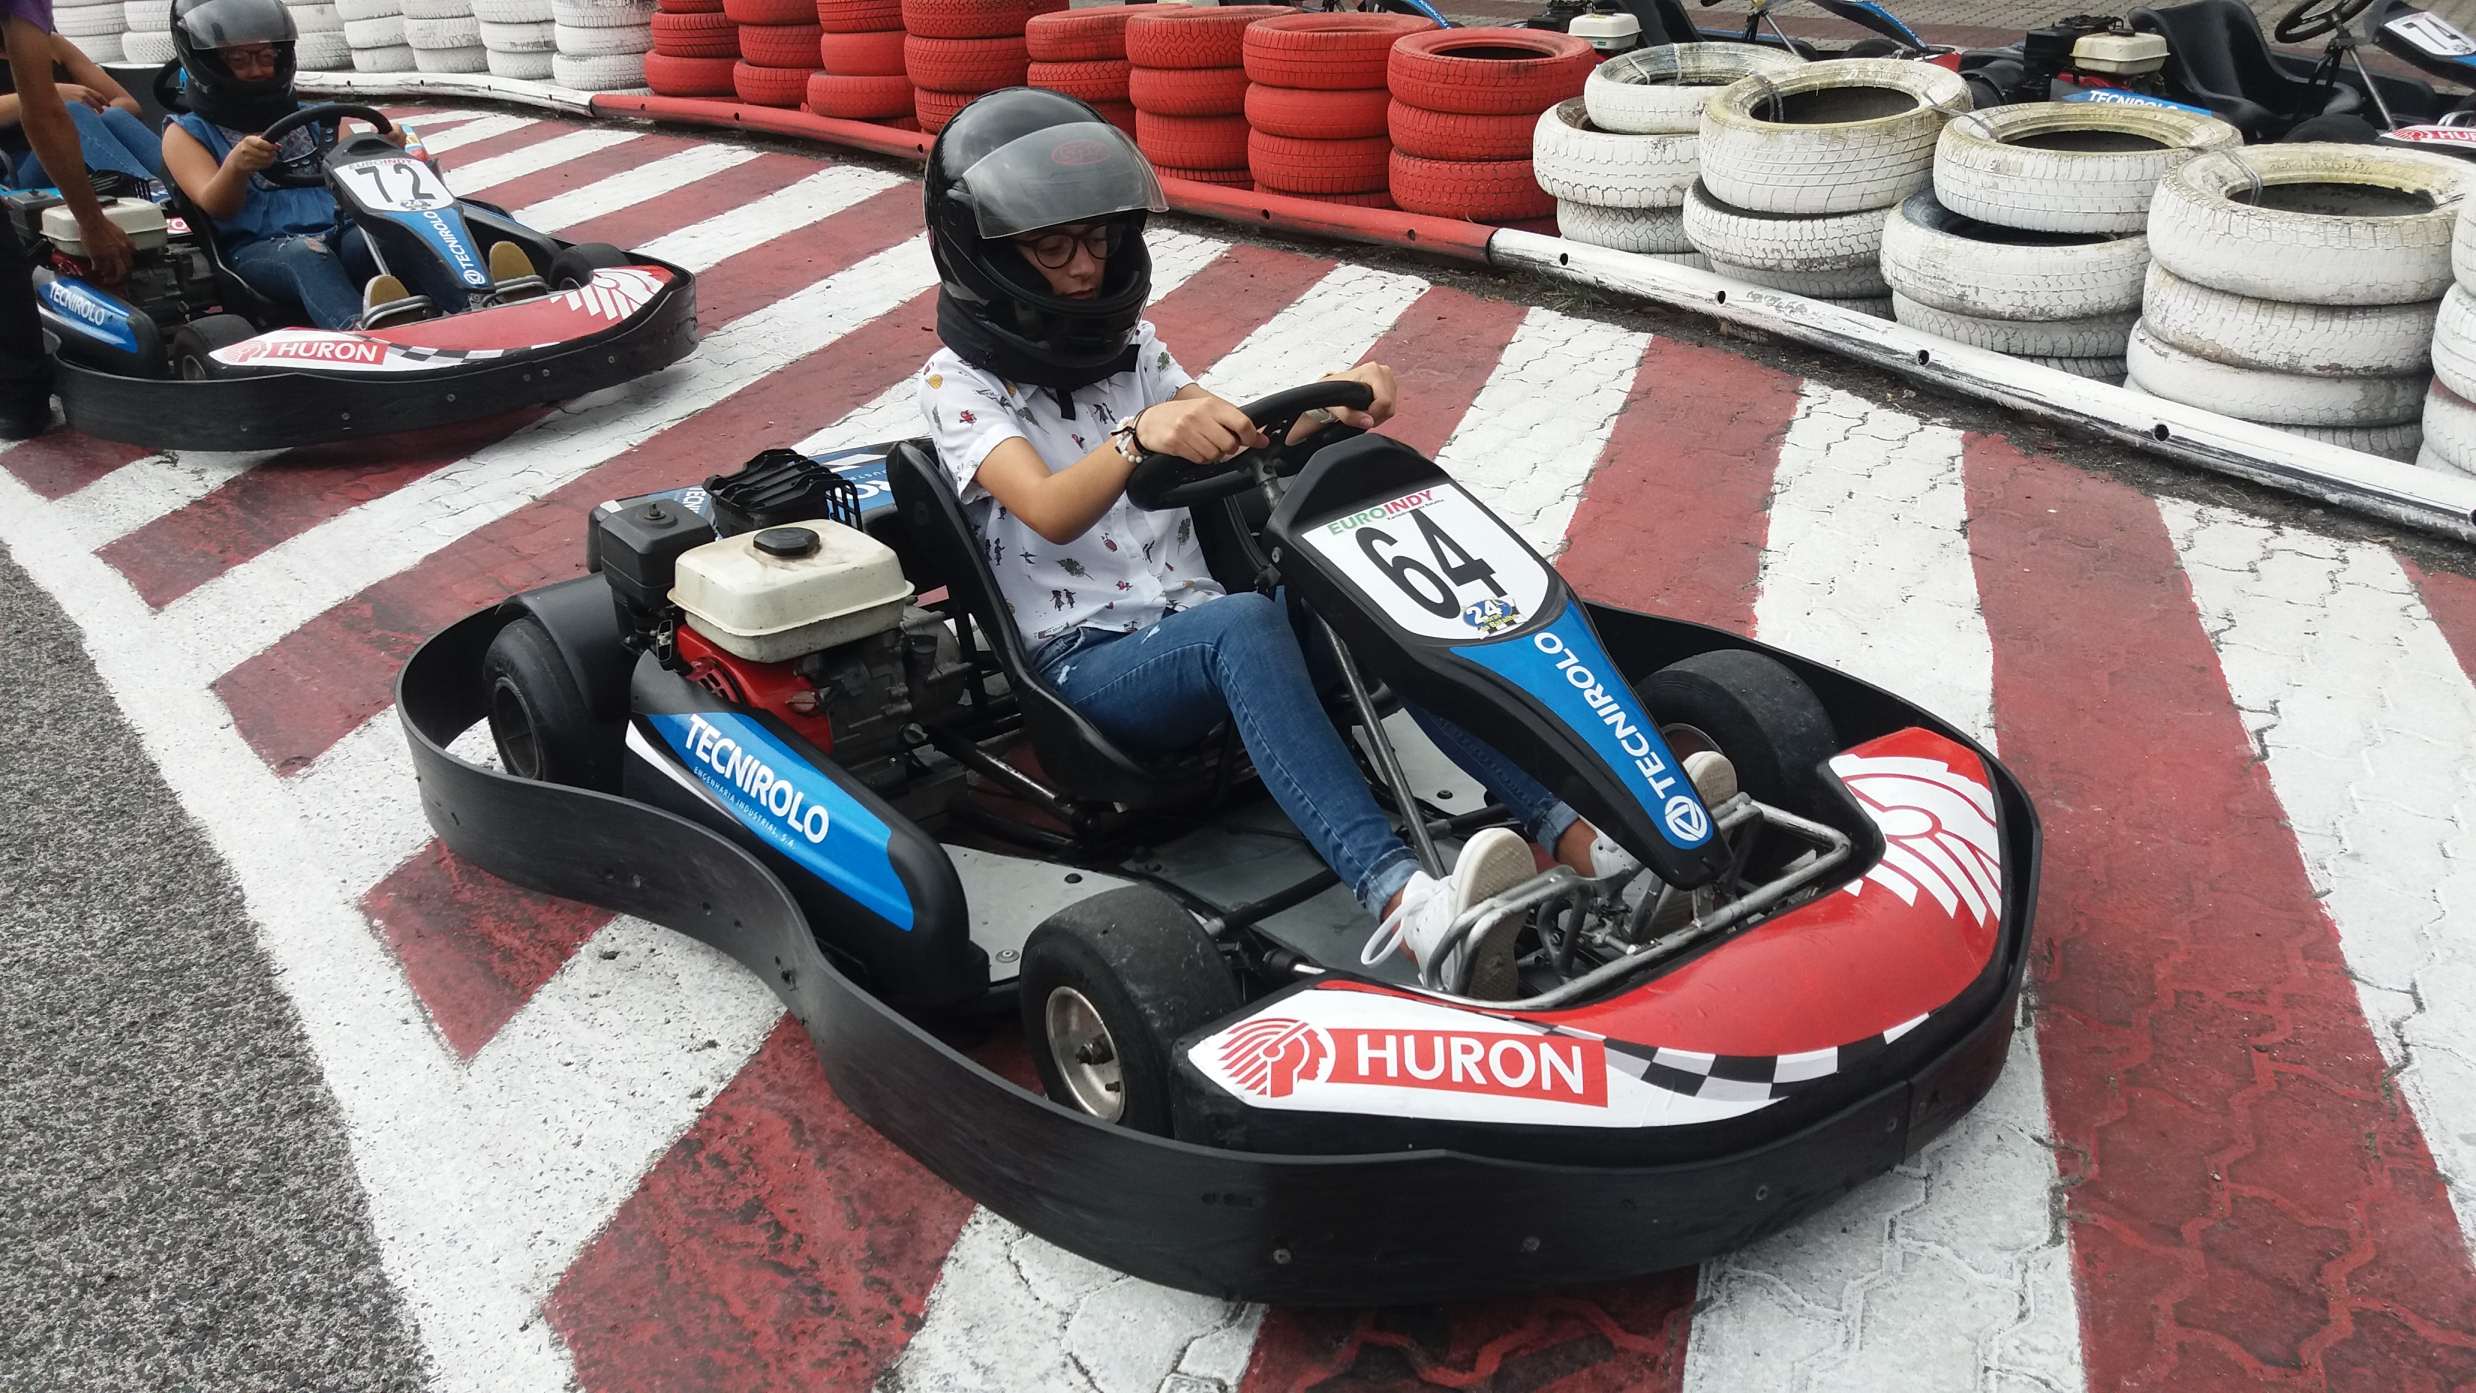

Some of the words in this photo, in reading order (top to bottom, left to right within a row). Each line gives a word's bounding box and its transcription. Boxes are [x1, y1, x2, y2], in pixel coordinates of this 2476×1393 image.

[2402, 17, 2469, 50] 74
[355, 165, 436, 203] 72
[424, 211, 474, 269] TECNIROLO
[50, 281, 105, 326] TECNIROLO
[277, 341, 378, 362] HURON
[1327, 489, 1433, 536] EUROINDY
[1355, 508, 1508, 619] 64
[1534, 632, 1675, 800] TECNIROLO
[685, 713, 830, 844] TECNIROLO
[693, 766, 735, 803] ENGENHARIA
[1356, 1034, 1584, 1095] HURON
